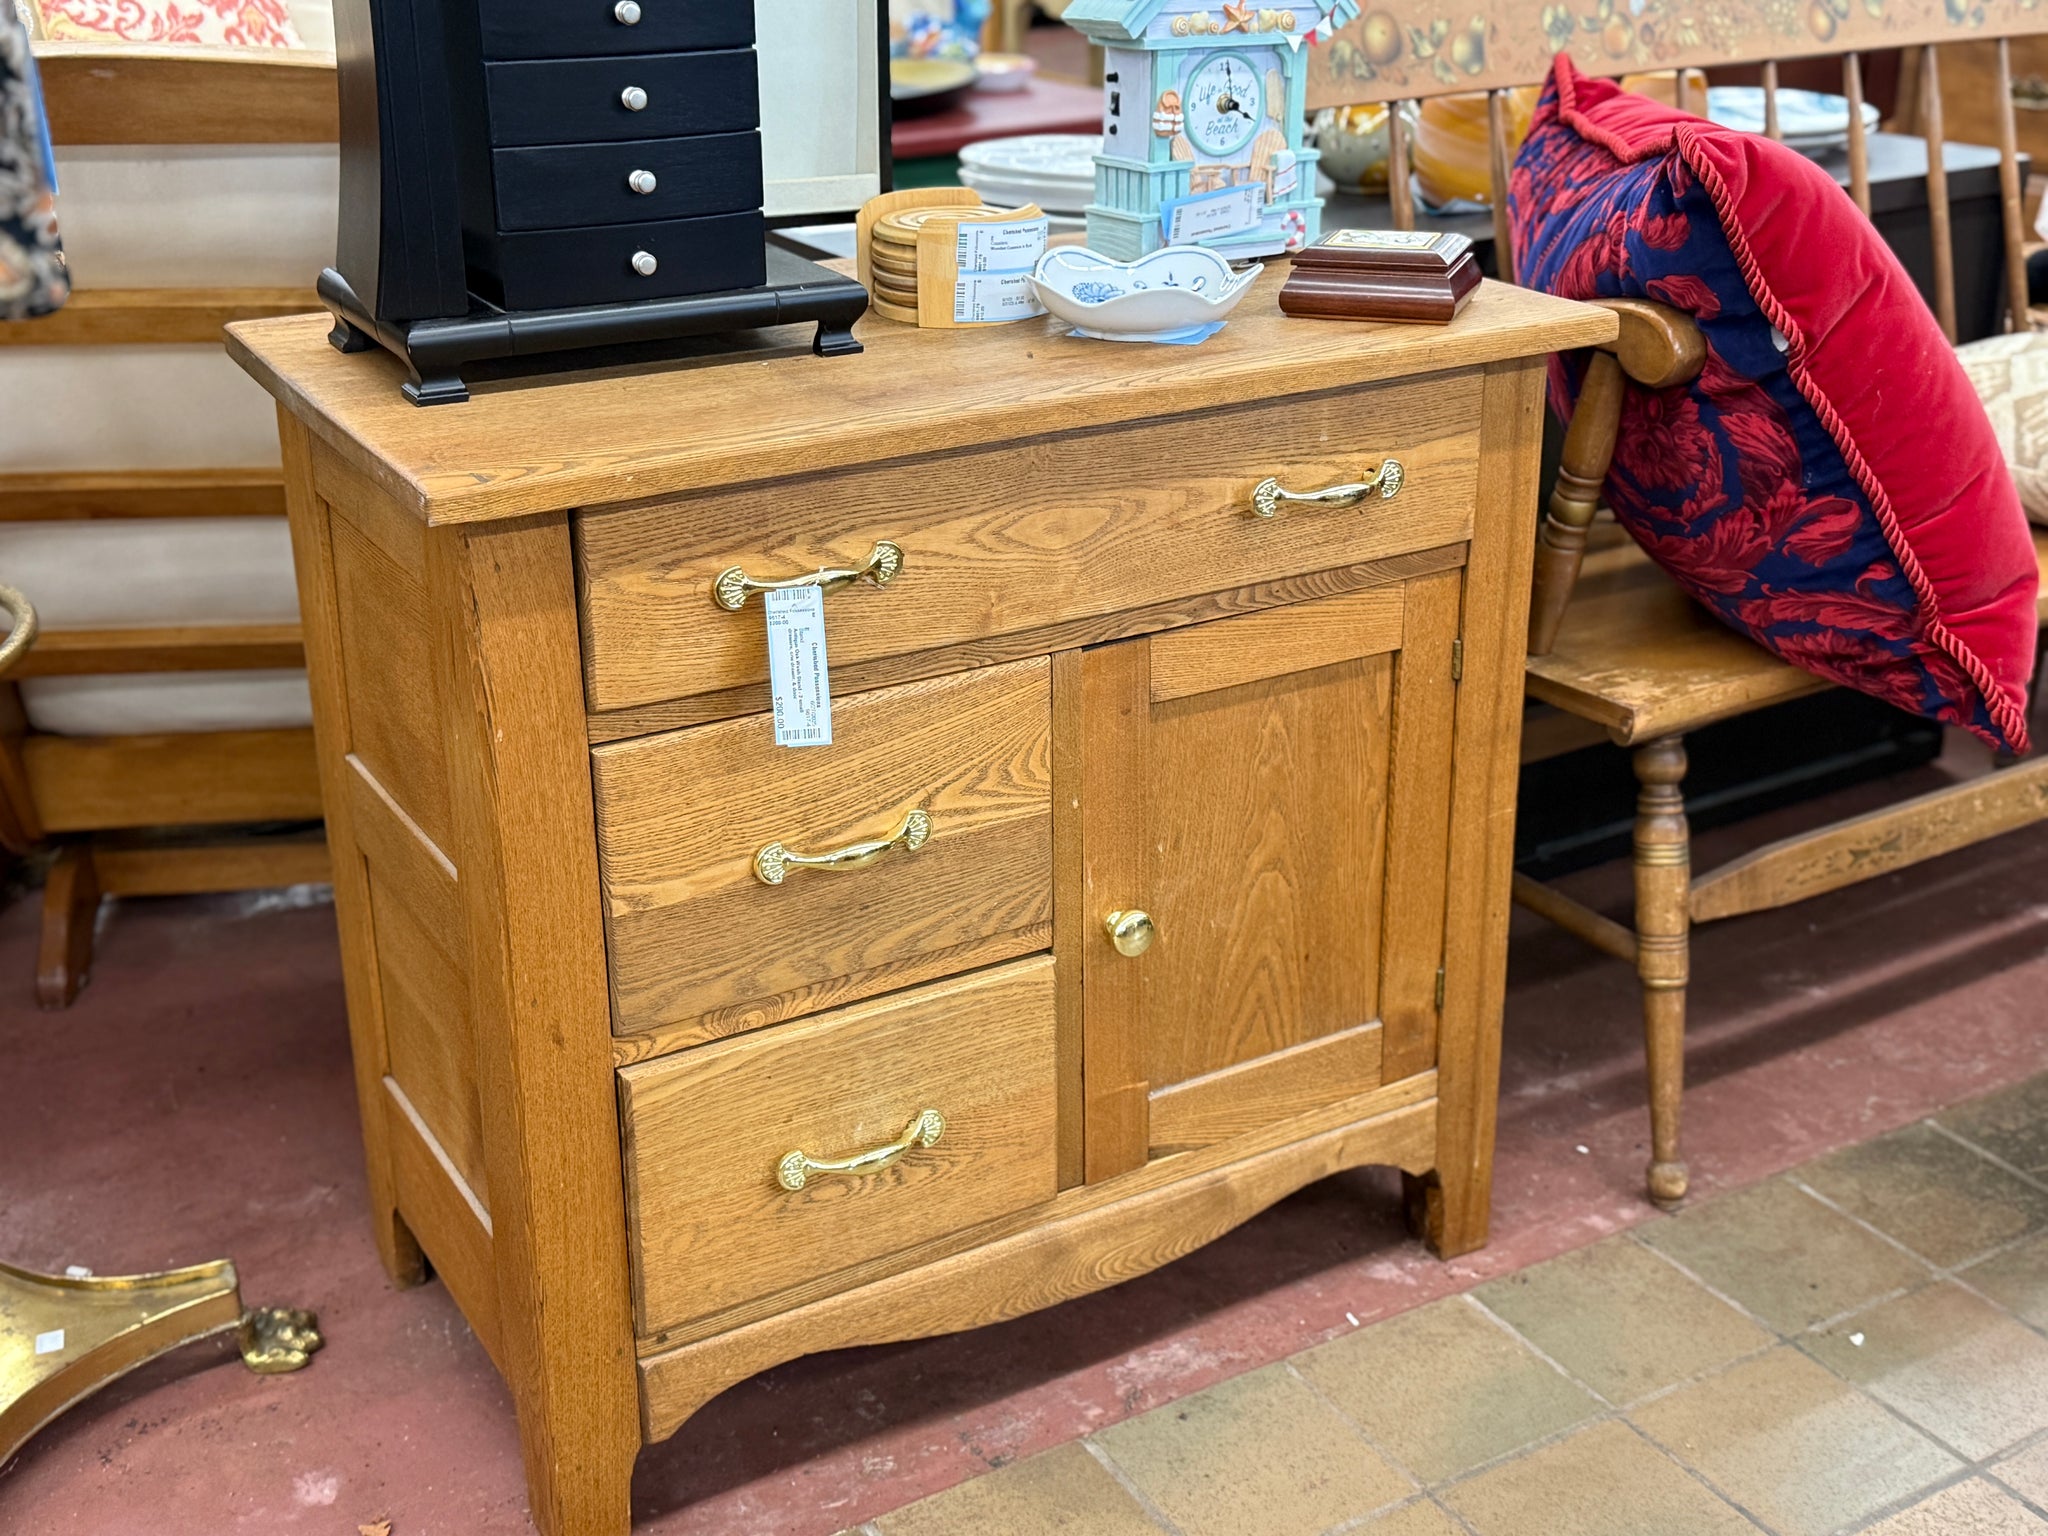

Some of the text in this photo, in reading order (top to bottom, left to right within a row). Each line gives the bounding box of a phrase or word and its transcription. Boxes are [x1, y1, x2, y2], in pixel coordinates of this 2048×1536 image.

[1199, 81, 1216, 105] Life
[1191, 102, 1196, 111] 9
[1249, 97, 1255, 106] 3
[1205, 118, 1239, 136] Beach
[1220, 137, 1225, 146] 6
[775, 696, 785, 729] $200.00
